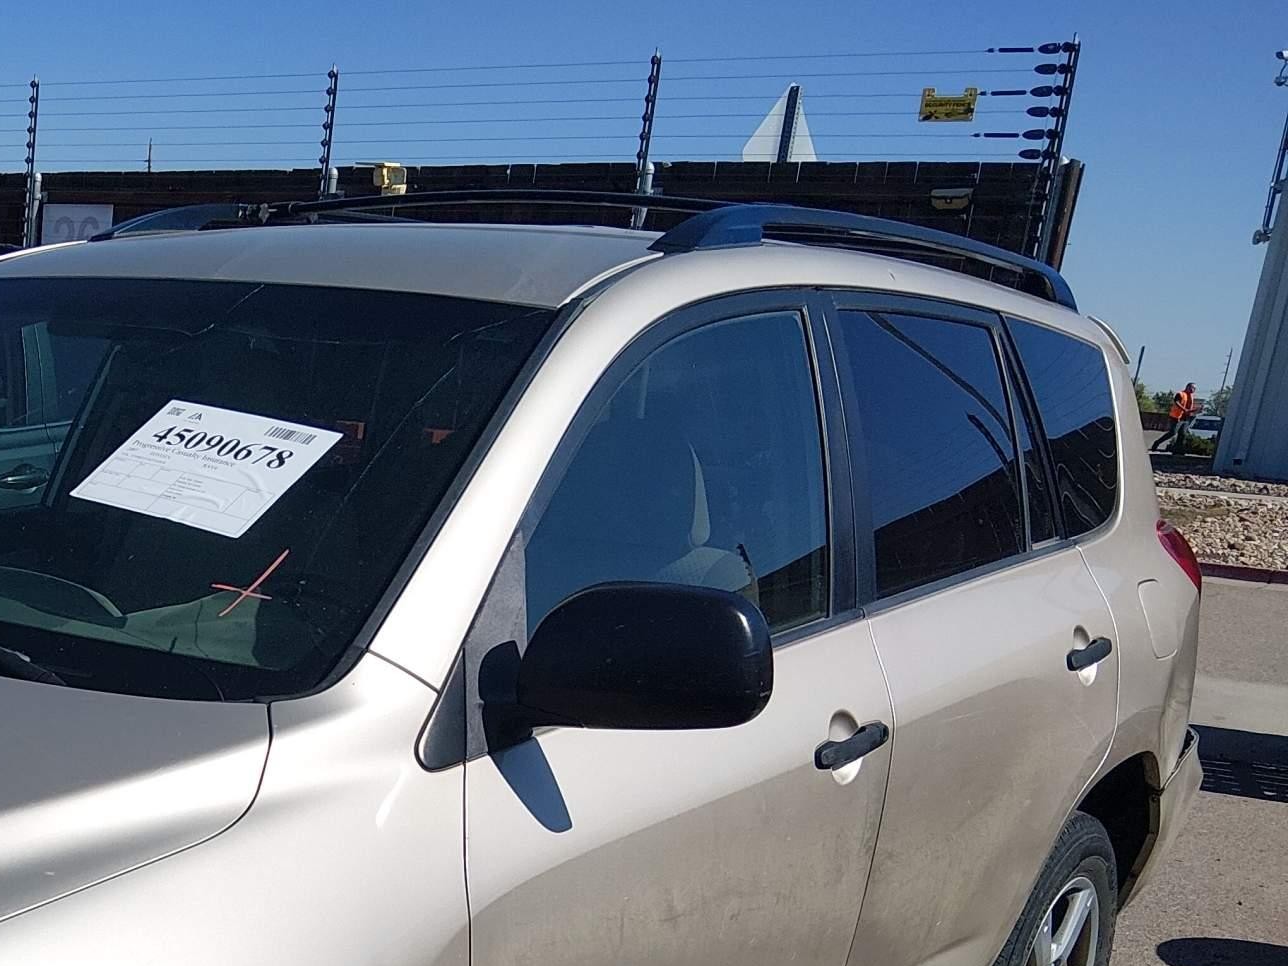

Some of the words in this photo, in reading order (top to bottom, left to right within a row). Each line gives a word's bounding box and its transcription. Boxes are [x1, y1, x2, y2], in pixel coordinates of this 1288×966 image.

[132, 440, 172, 454] Progressive
[171, 446, 200, 461] Casualty
[201, 454, 237, 468] Insurance
[152, 425, 294, 470] 45090678
